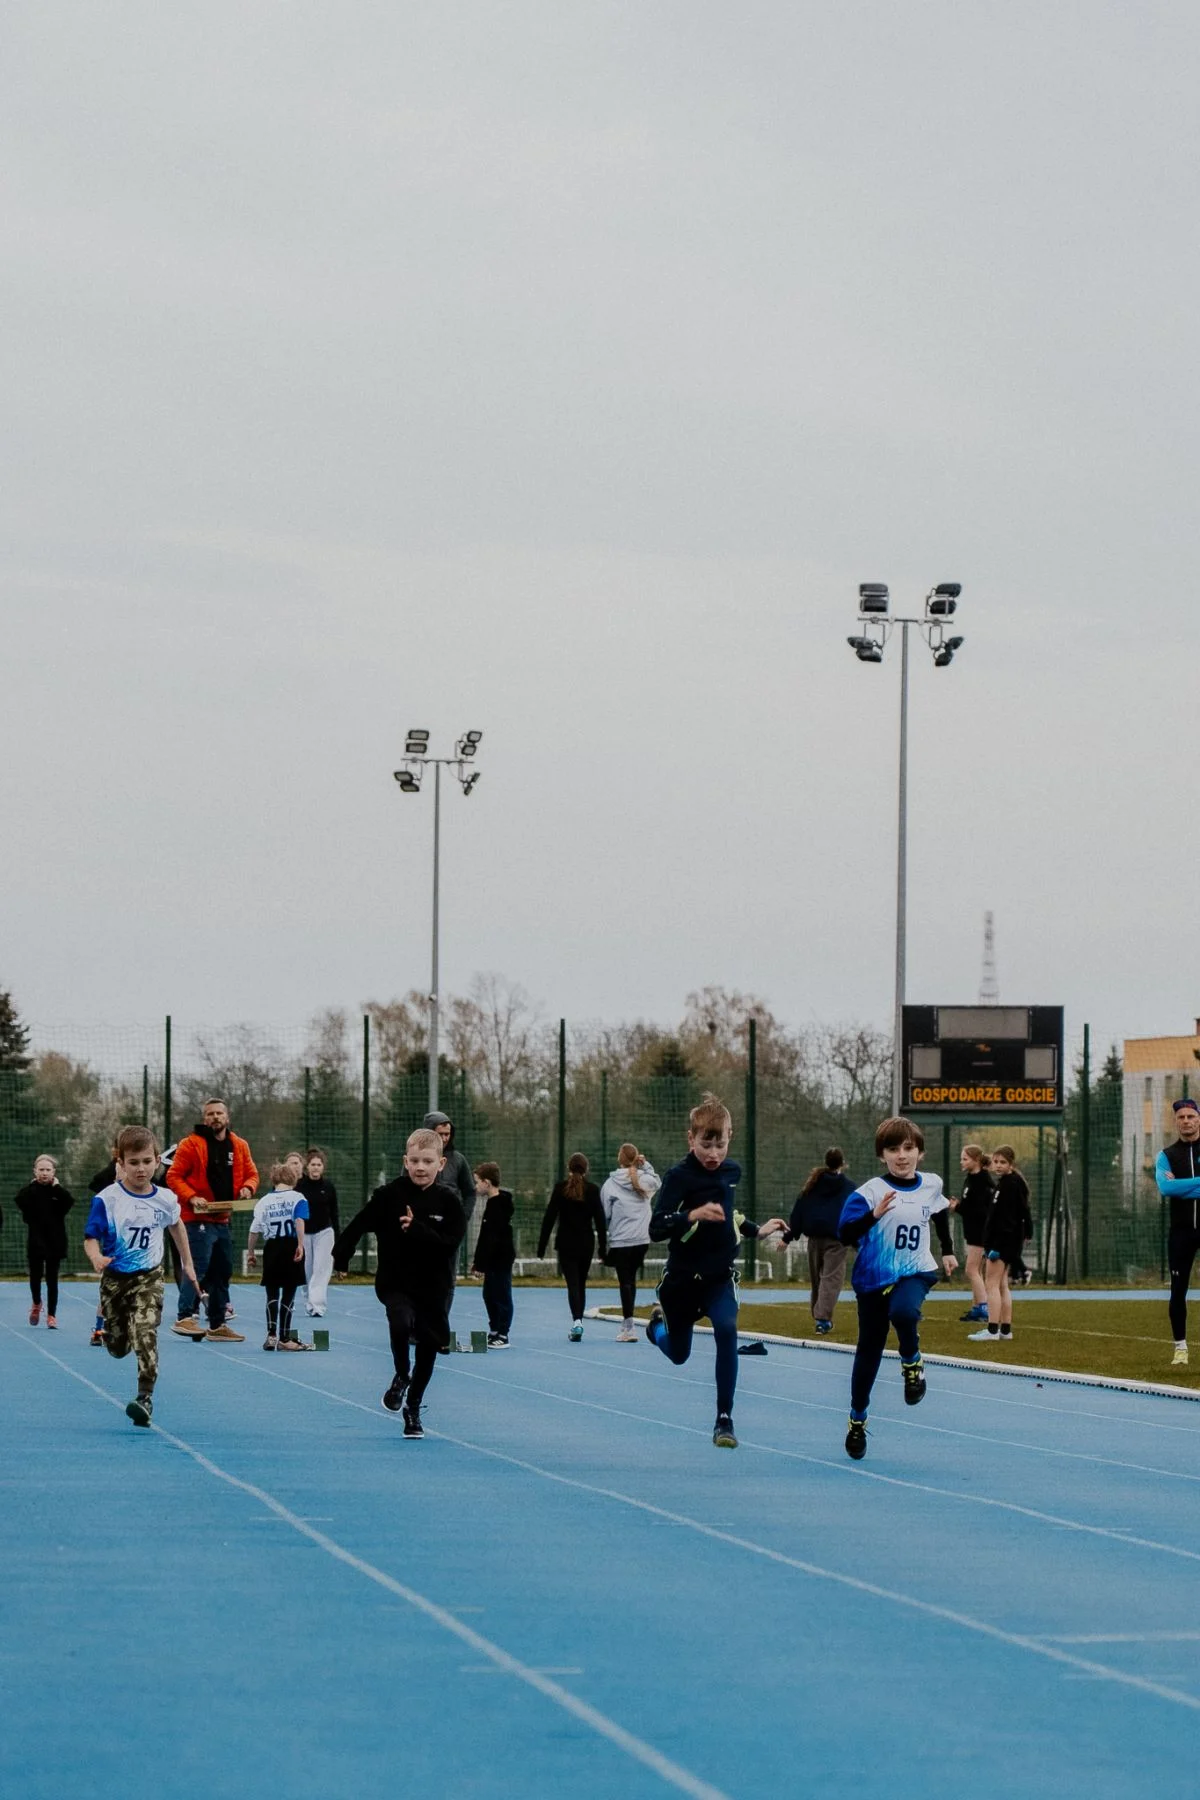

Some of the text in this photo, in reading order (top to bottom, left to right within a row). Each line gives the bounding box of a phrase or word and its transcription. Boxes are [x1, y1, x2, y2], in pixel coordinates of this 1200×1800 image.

[912, 1087, 1001, 1102] GOSPODARZE
[128, 1227, 151, 1249] 76
[270, 1219, 295, 1238] 70
[895, 1224, 921, 1251] 69
